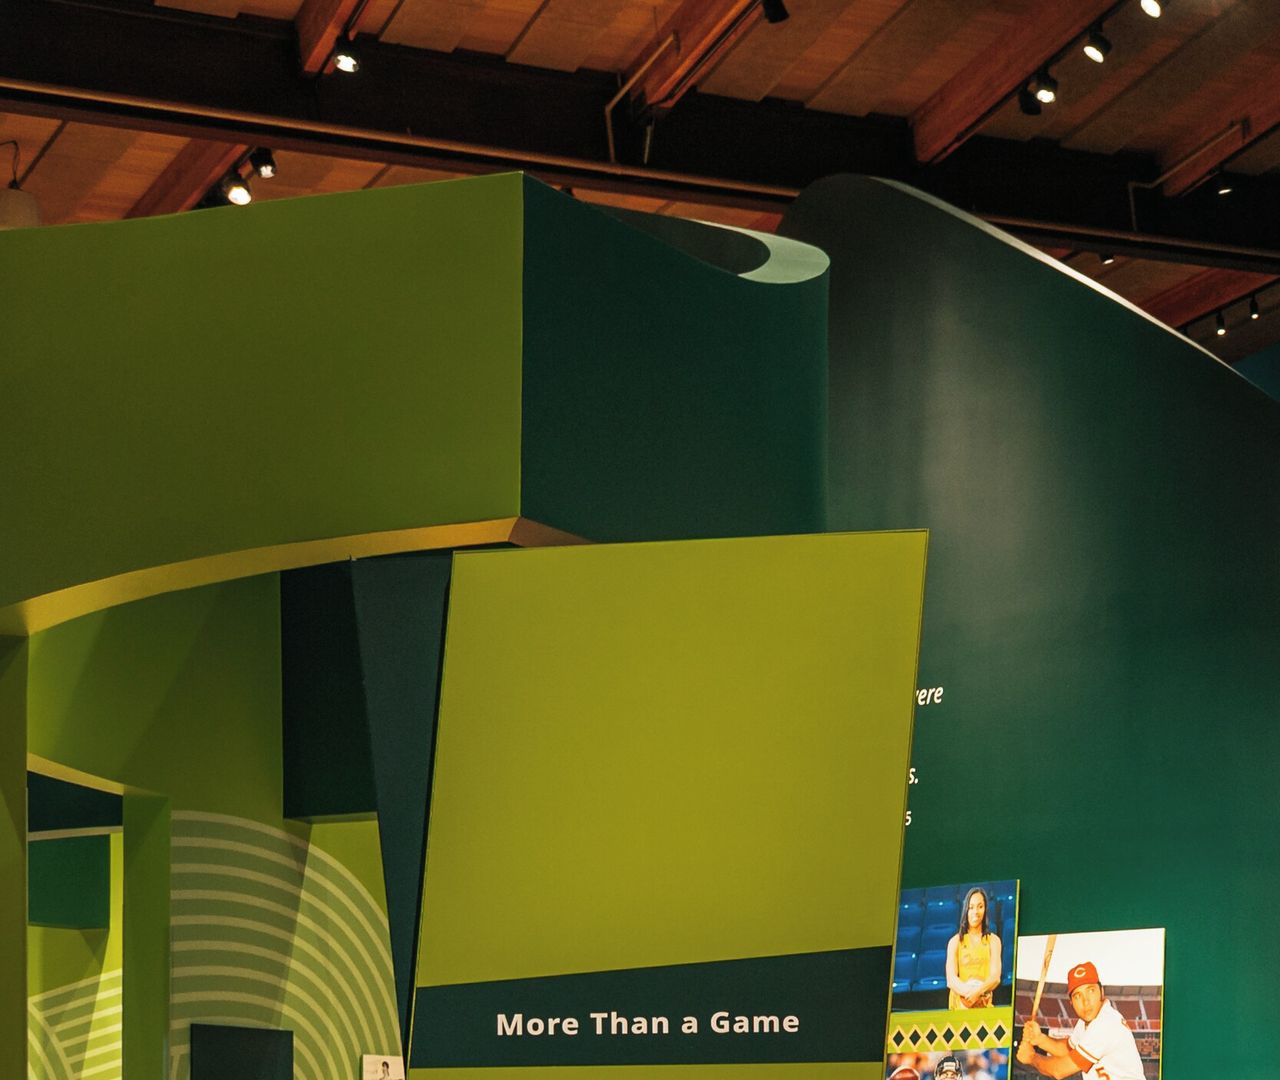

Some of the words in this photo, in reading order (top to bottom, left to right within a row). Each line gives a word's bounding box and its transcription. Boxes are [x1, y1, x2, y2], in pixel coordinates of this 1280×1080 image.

[916, 686, 944, 706] ere
[497, 1013, 579, 1036] More
[589, 1011, 669, 1035] Than
[681, 1016, 698, 1034] a
[710, 1011, 800, 1034] Game
